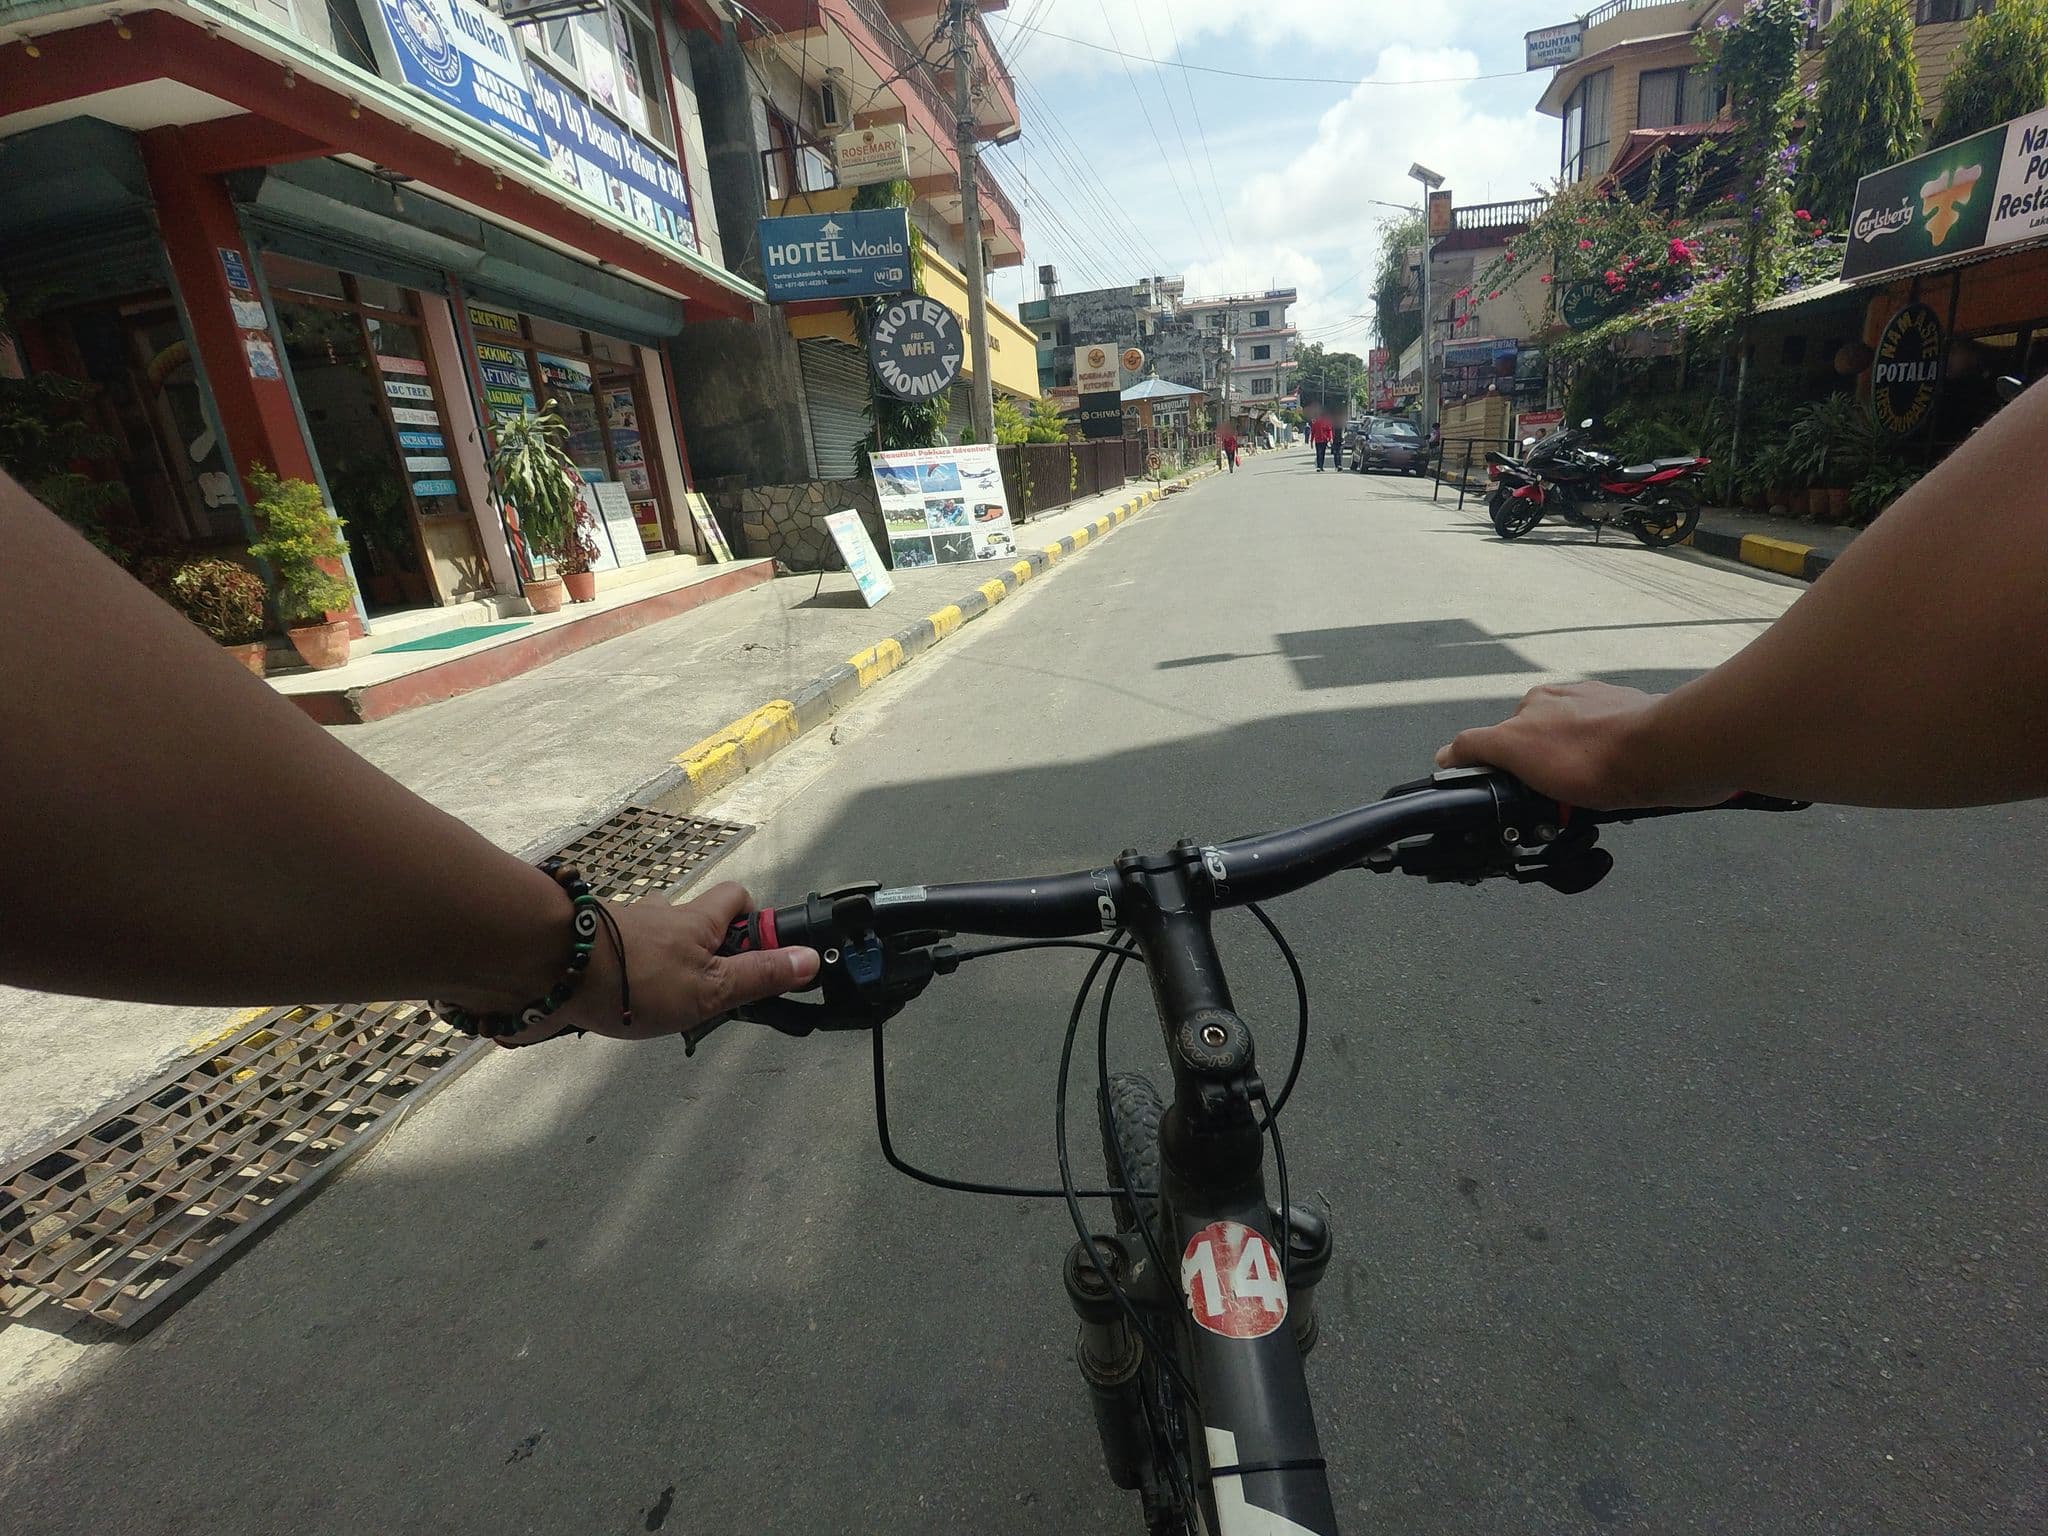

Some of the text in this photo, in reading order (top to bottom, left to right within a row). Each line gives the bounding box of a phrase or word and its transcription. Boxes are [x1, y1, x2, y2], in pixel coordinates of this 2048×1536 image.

[450, 0, 511, 63] Ruslan
[1530, 34, 1581, 50] MOUNTAIN
[472, 62, 527, 111] HOTEL
[472, 81, 540, 136] MONILA
[530, 67, 562, 130] Step
[559, 89, 584, 144] Up
[581, 105, 623, 170] Beauty
[667, 166, 688, 205] SPA
[841, 140, 897, 158] ROSEMARY
[2018, 124, 2048, 156] Na
[1854, 196, 1916, 241] Carlsberg
[768, 236, 903, 266] HOTEL Monila
[875, 300, 950, 343] HOTEL
[911, 332, 925, 340] FREE
[879, 354, 960, 396] MONILA
[1079, 371, 1116, 380] ROSEMARY
[1083, 381, 1114, 391] KITCHEN
[1876, 361, 1938, 383] POTALA
[385, 384, 429, 398] ABC TREK
[1090, 409, 1120, 419] CHIVAS
[1182, 1237, 1287, 1317] 14
